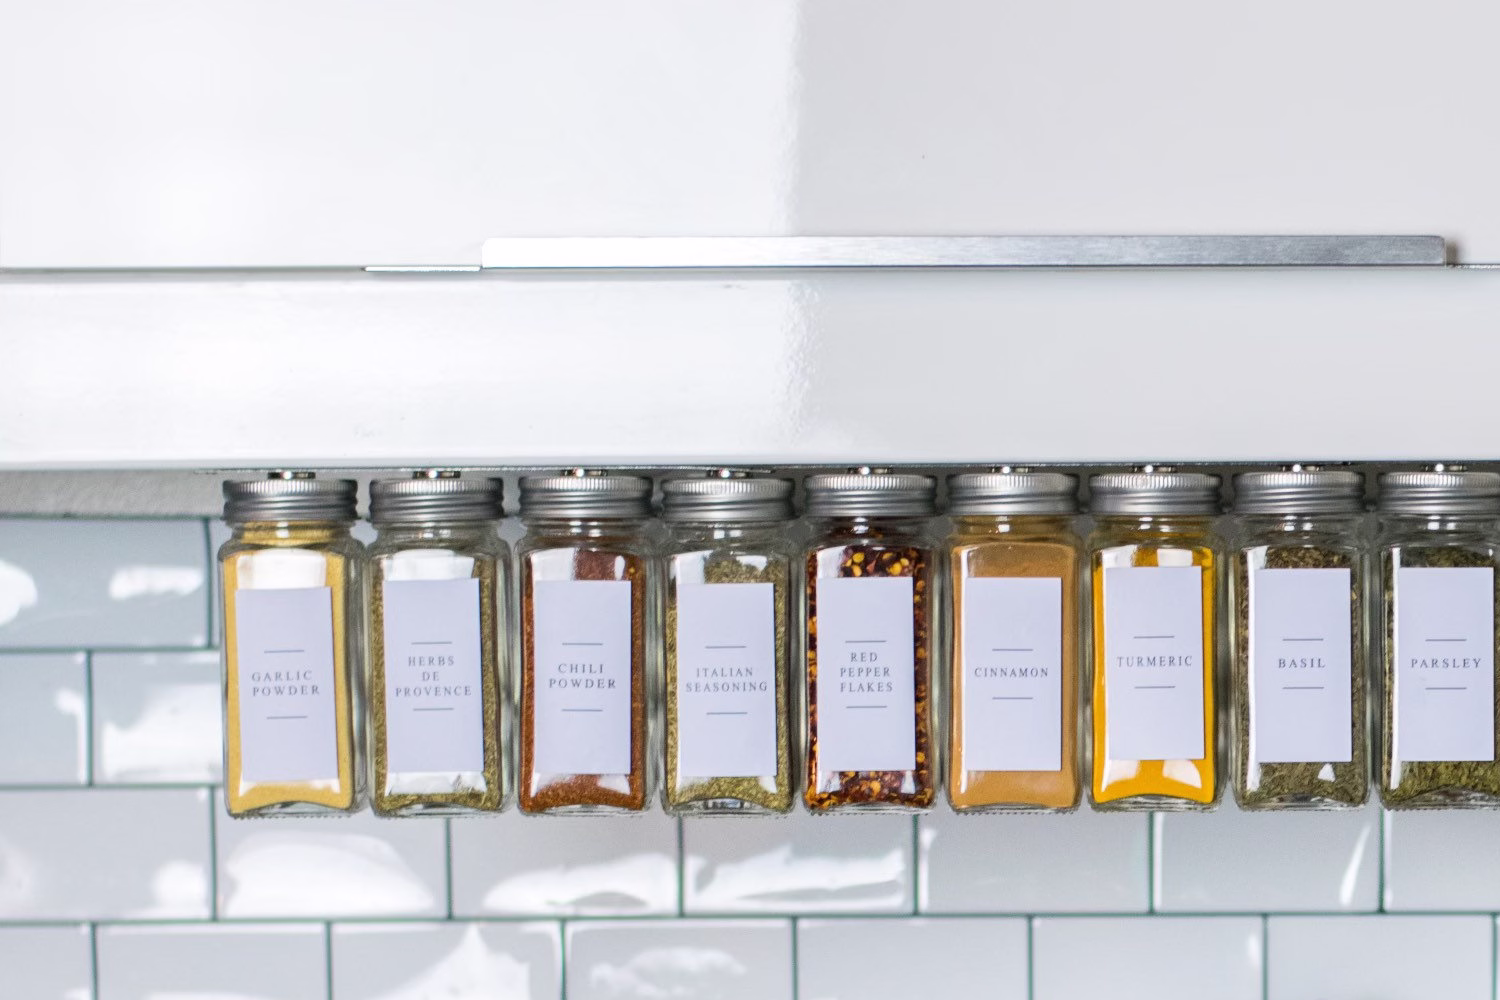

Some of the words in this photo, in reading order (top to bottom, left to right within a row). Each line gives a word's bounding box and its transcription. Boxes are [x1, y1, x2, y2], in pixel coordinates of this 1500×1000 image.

[408, 655, 454, 666] HERBS
[850, 652, 878, 663] RED
[1117, 655, 1193, 667] TURMERIC
[1278, 657, 1326, 669] BASIL
[1411, 657, 1482, 669] PARSLEY
[557, 663, 604, 674] CHILI
[696, 667, 753, 678] ITALIAN
[840, 666, 890, 678] PEPPER
[974, 667, 1048, 678] CINNAMON
[251, 670, 313, 683] GARLIC
[422, 671, 440, 682] DE
[549, 678, 616, 689] POWDER
[686, 681, 768, 693] SEASONING
[840, 681, 893, 693] FLAKES
[252, 684, 320, 696] POWDER
[395, 685, 472, 697] PROVENCE
